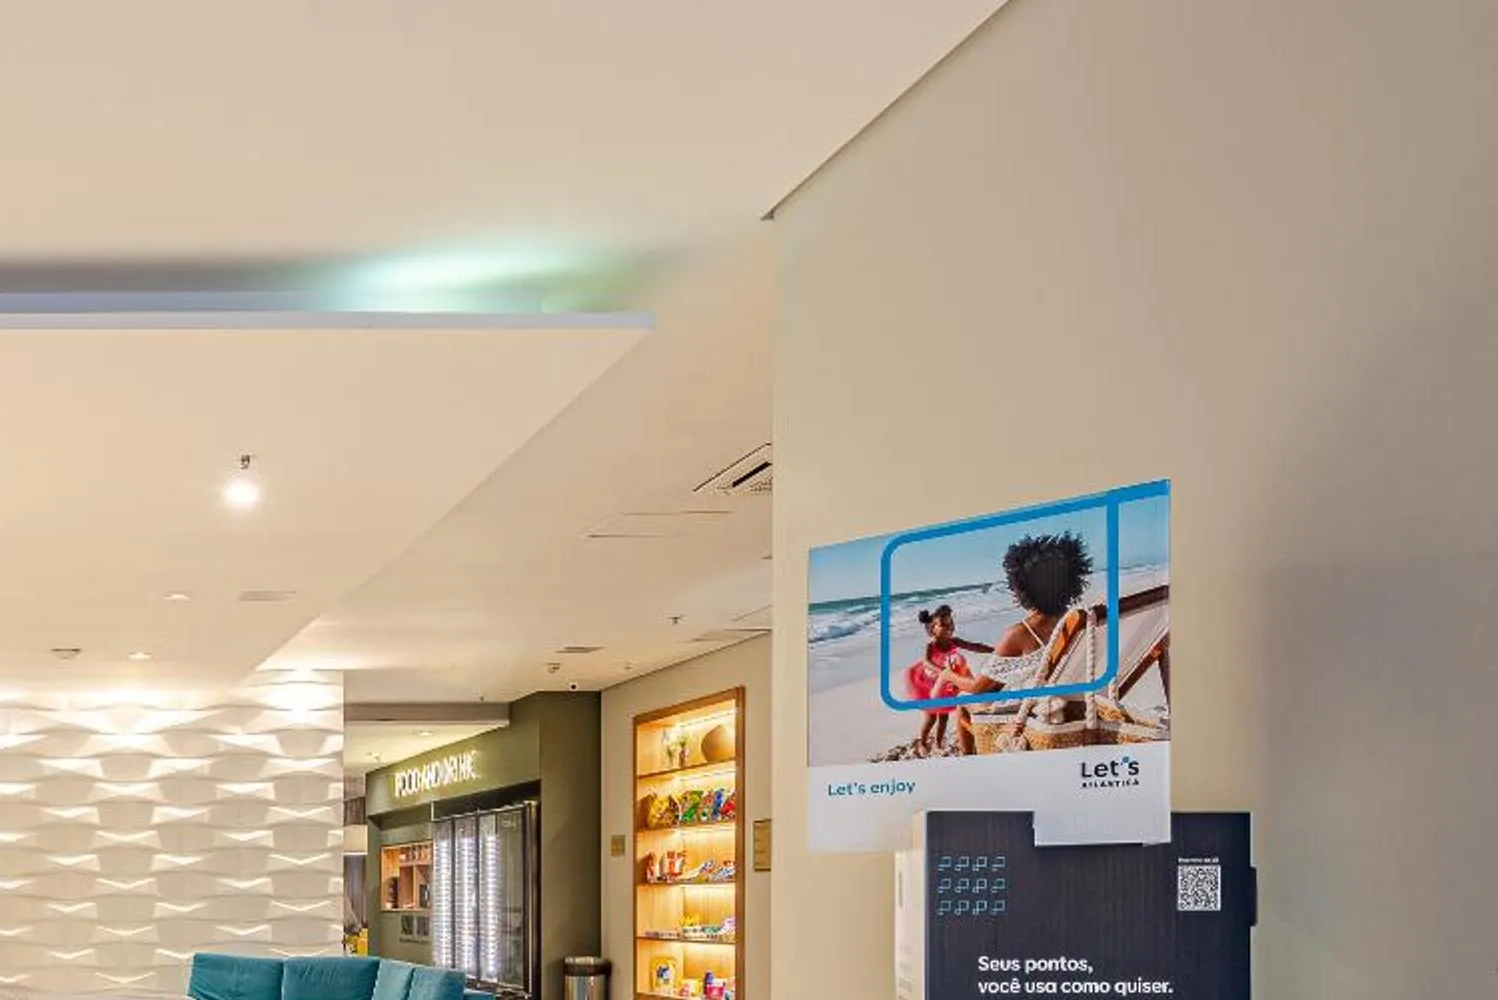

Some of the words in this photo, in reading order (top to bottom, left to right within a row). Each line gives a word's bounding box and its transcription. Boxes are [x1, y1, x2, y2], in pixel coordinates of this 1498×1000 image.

[1081, 756, 1140, 778] Let's
[828, 782, 866, 796] Let's
[870, 778, 916, 796] enjoy
[978, 956, 1021, 972] Seus
[1025, 956, 1094, 975] pontos,
[978, 977, 1021, 993] você
[1025, 981, 1057, 993] usa
[1060, 981, 1111, 994] como
[1114, 976, 1174, 996] quiser.
